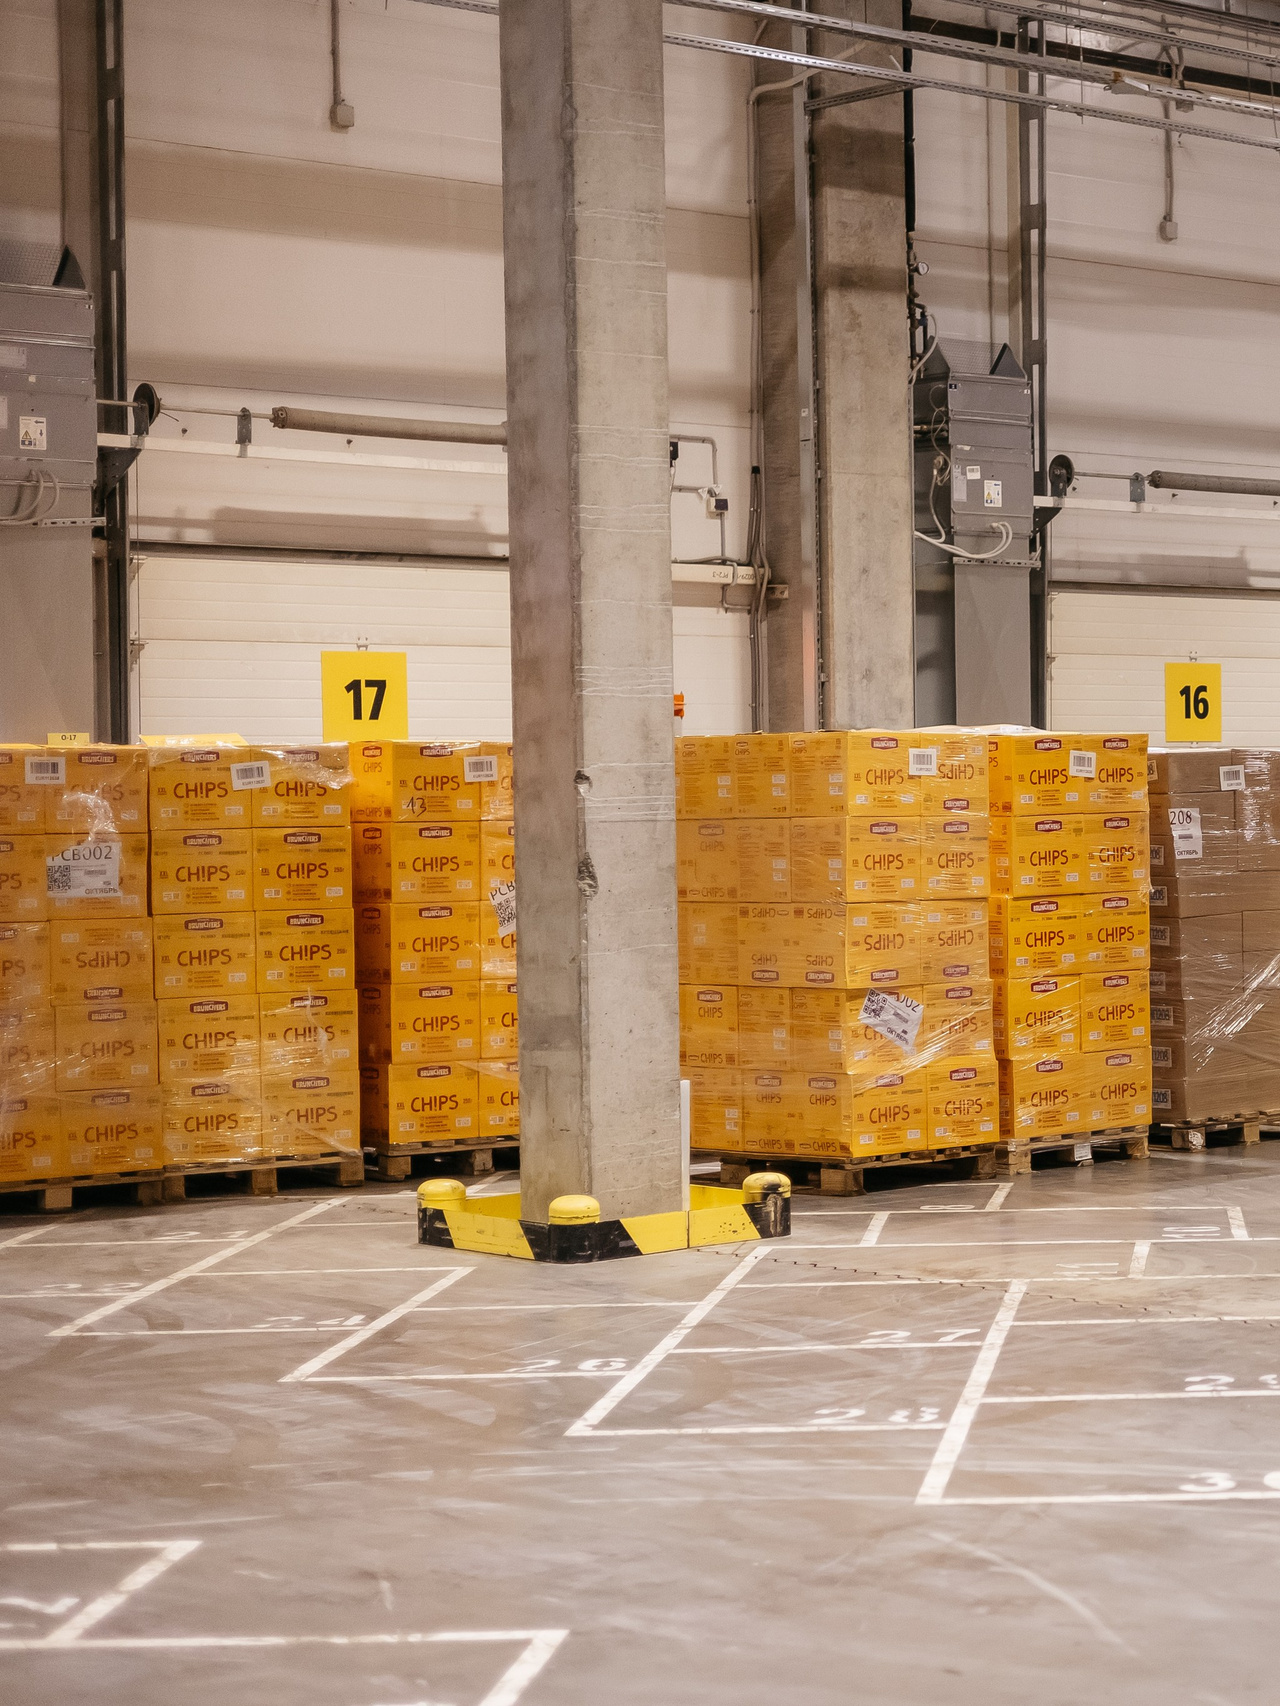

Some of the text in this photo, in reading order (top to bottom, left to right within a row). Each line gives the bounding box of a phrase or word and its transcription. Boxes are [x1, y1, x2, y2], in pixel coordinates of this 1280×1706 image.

[344, 679, 387, 720] 17
[1179, 685, 1209, 719] 16
[1170, 810, 1192, 825] 208
[861, 1328, 982, 1344] 27
